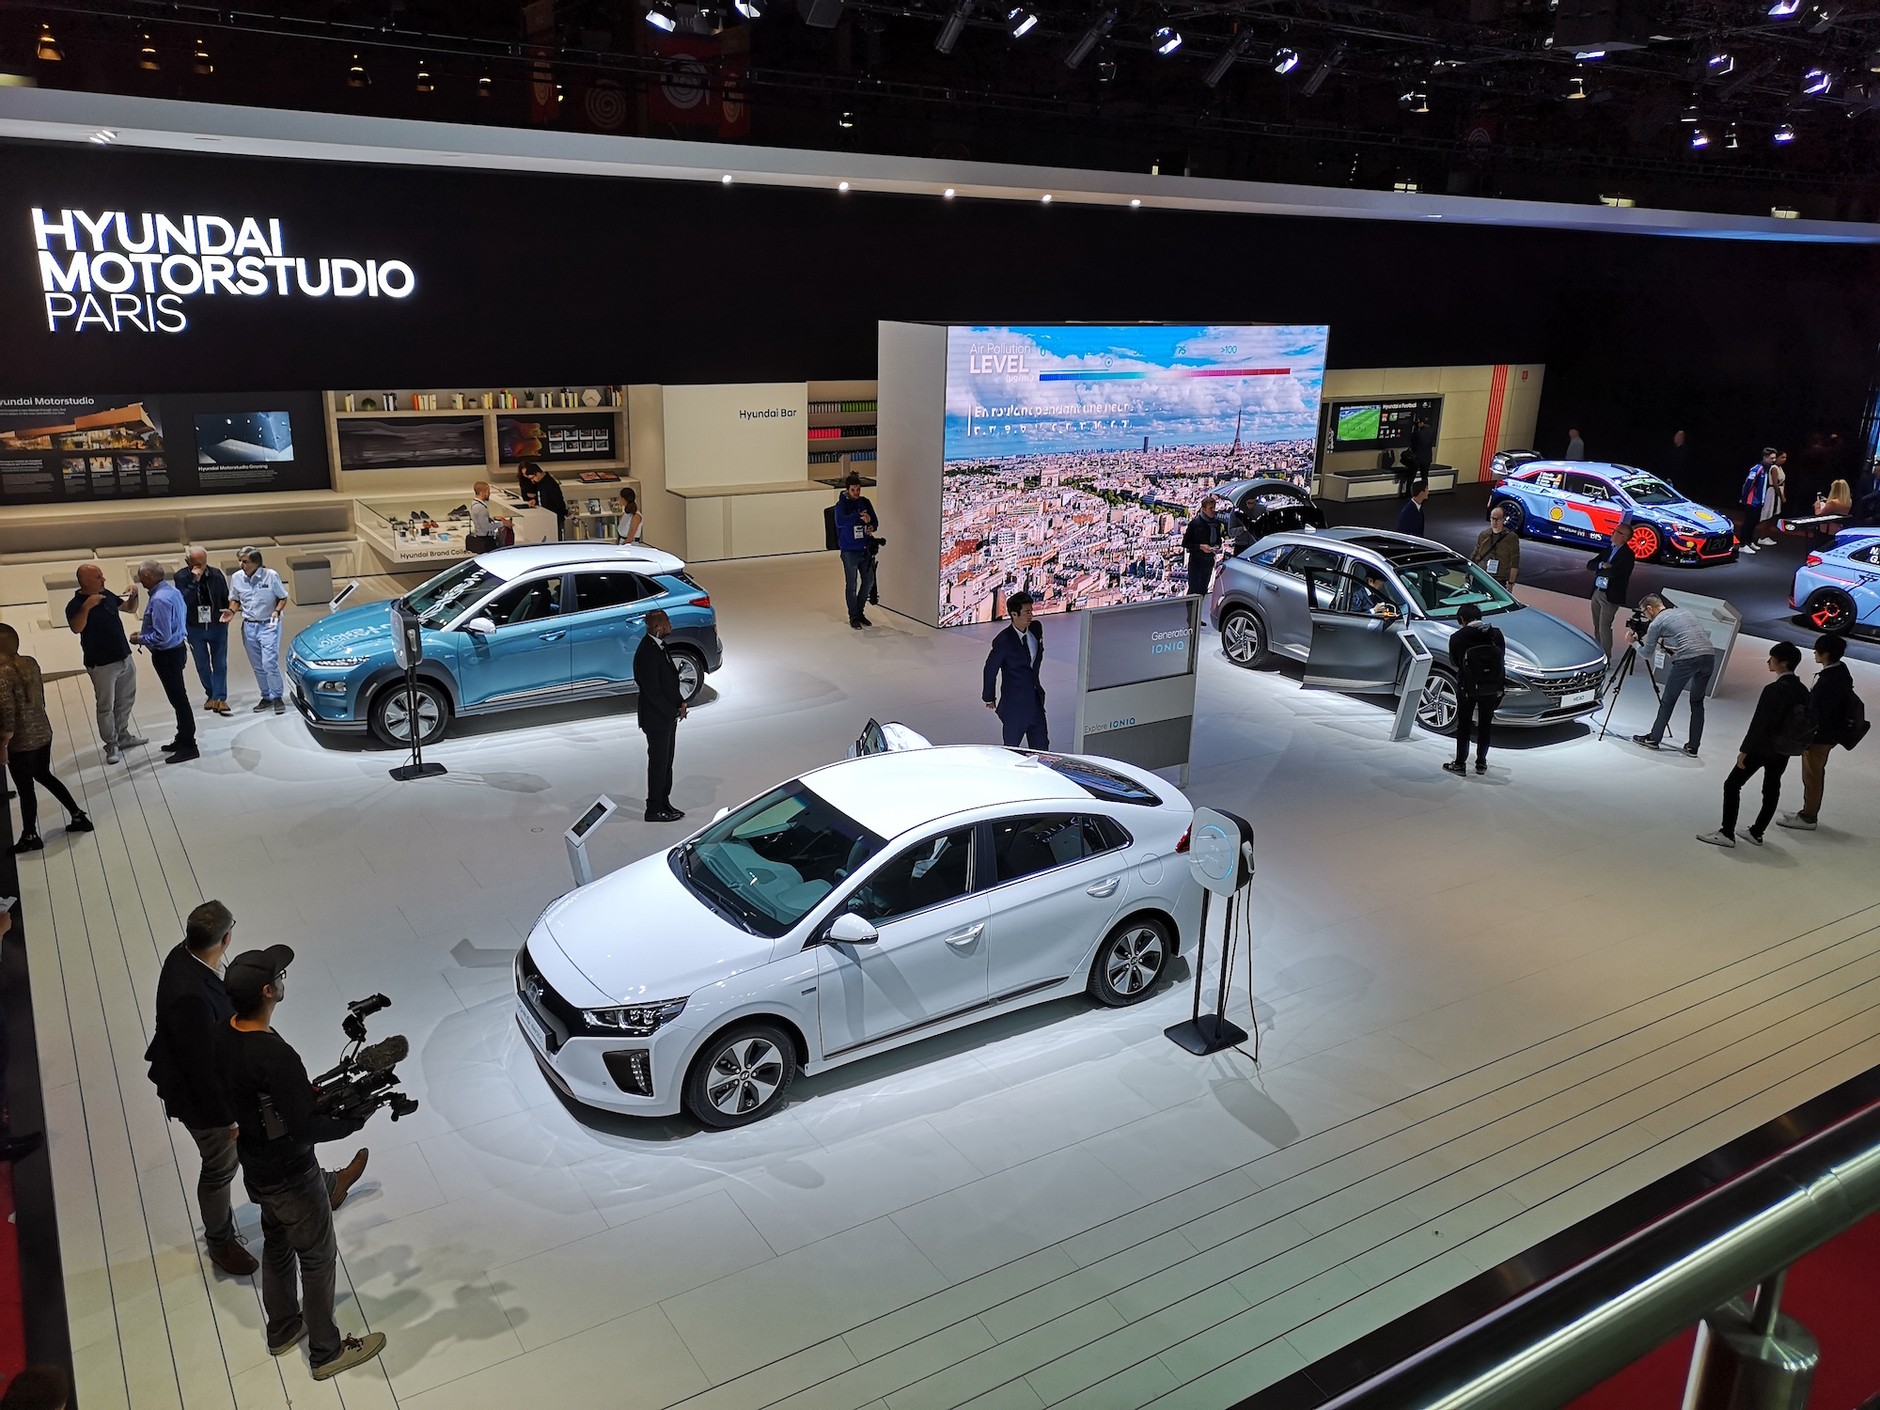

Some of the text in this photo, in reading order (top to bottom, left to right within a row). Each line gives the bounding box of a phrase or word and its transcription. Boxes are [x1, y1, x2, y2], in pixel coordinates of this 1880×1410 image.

[31, 207, 283, 257] HYUNDAI
[37, 249, 415, 298] MOTORSTUDIO
[46, 292, 188, 333] PARIS
[969, 342, 1031, 354] Air Pollution
[970, 354, 1030, 373] LEVEL
[35, 396, 95, 406] Motorstudio
[739, 408, 797, 421] Hyundai Bar
[400, 551, 429, 560] Hyundai
[1151, 627, 1193, 641] Generation
[1151, 640, 1184, 654] IONIQ
[1084, 717, 1136, 734] Explore IONIQ
